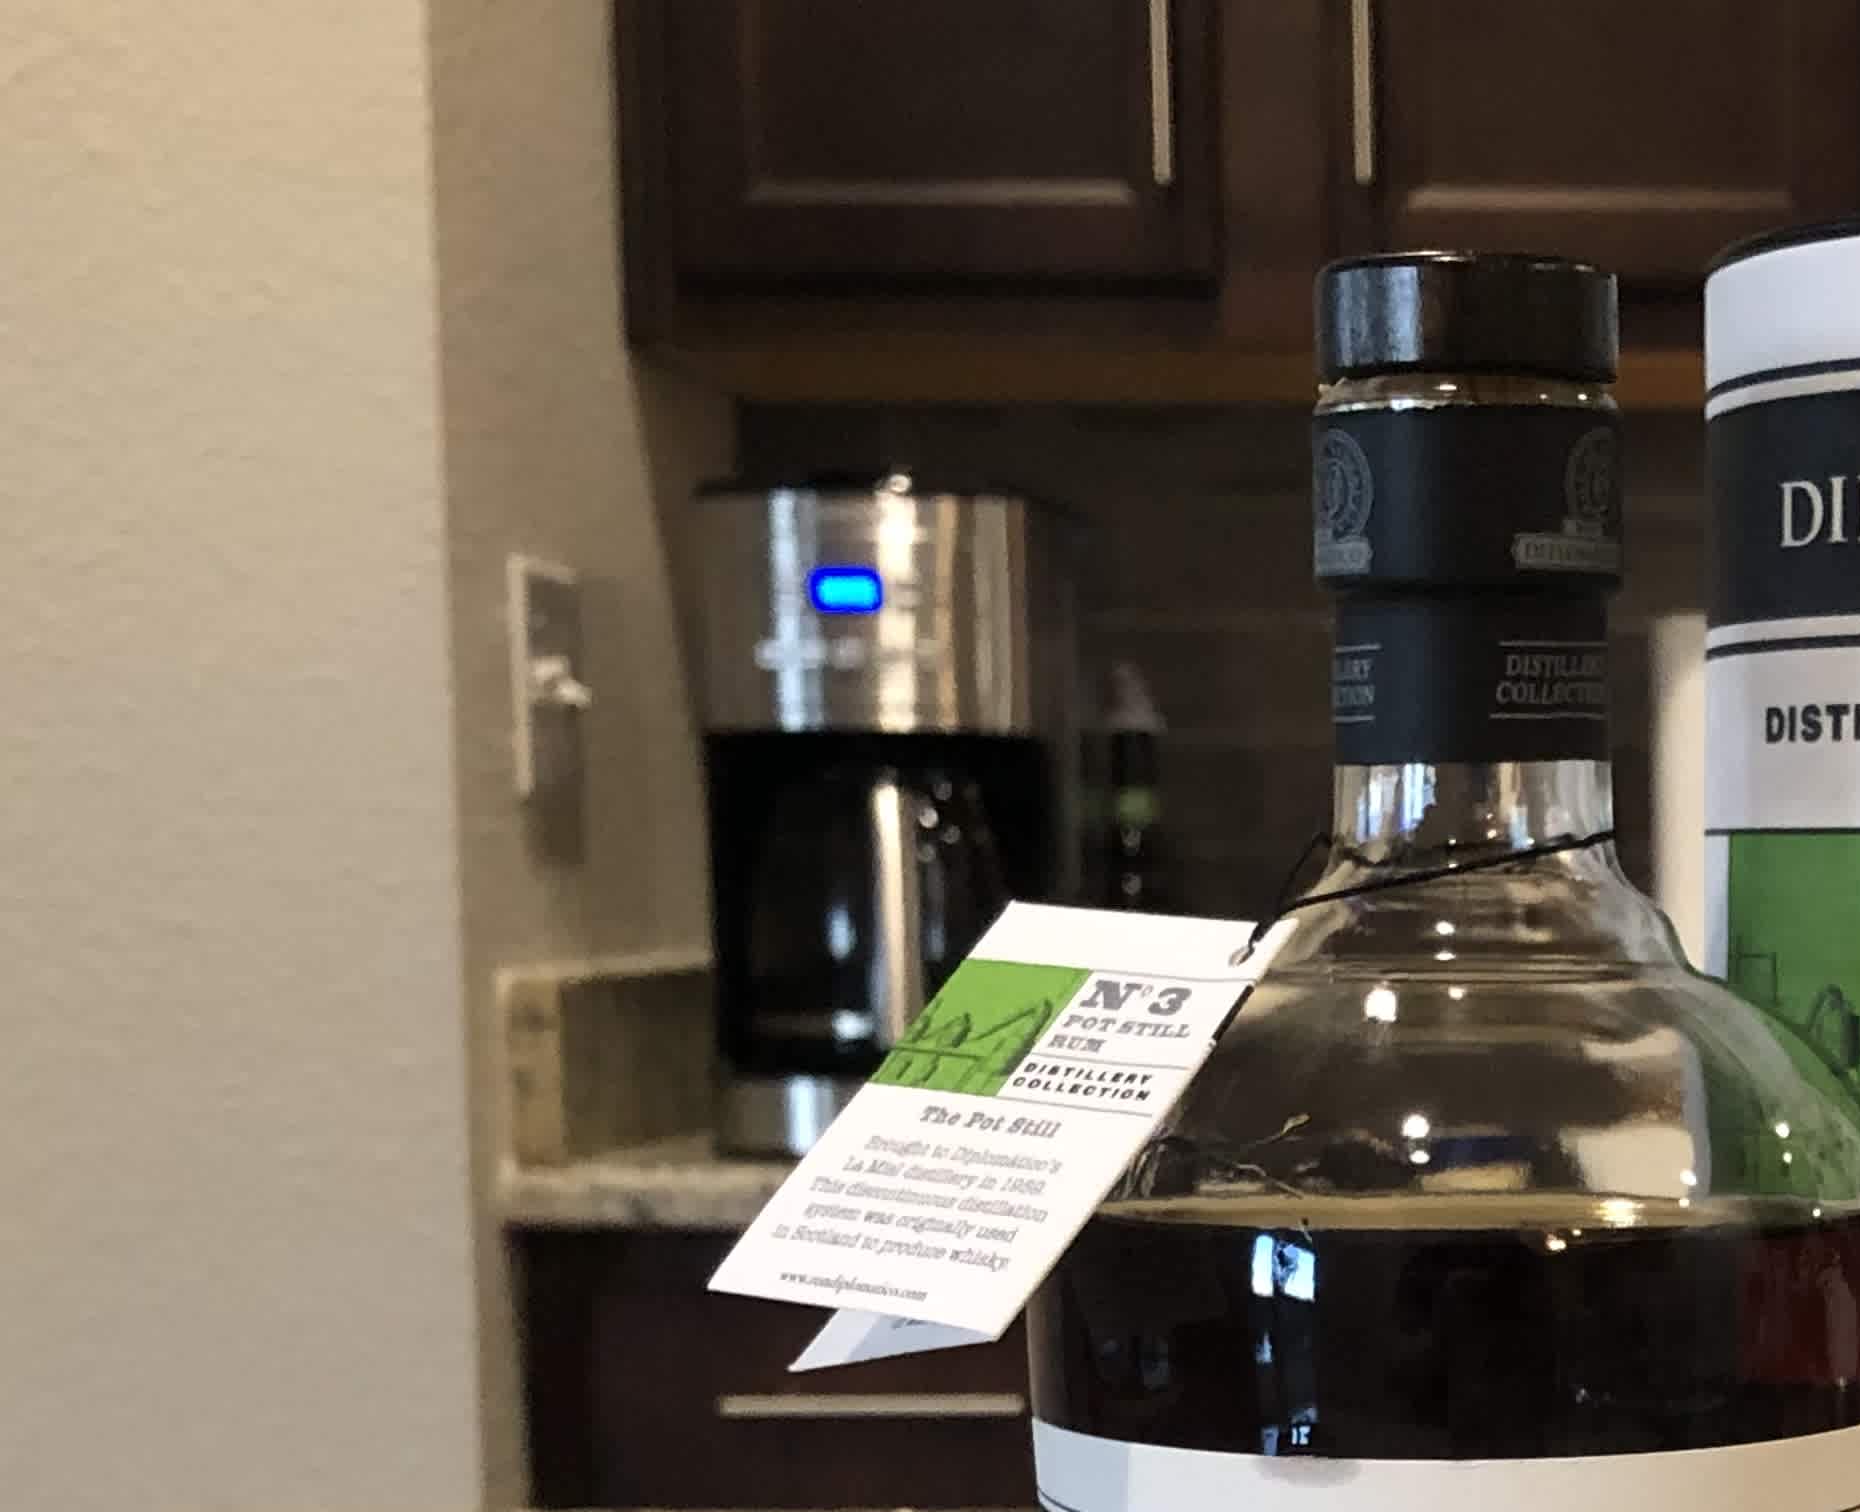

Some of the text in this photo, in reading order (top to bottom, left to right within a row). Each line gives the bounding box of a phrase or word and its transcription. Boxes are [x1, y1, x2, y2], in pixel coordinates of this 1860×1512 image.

[1148, 986, 1193, 1017] 3
[1063, 1014, 1192, 1039] POT STILL
[1047, 1033, 1107, 1053] RUM
[1023, 1061, 1153, 1085] DISTILLERY
[1012, 1076, 1151, 1101] COLLECTION
[919, 1105, 1062, 1139] The Pot Still
